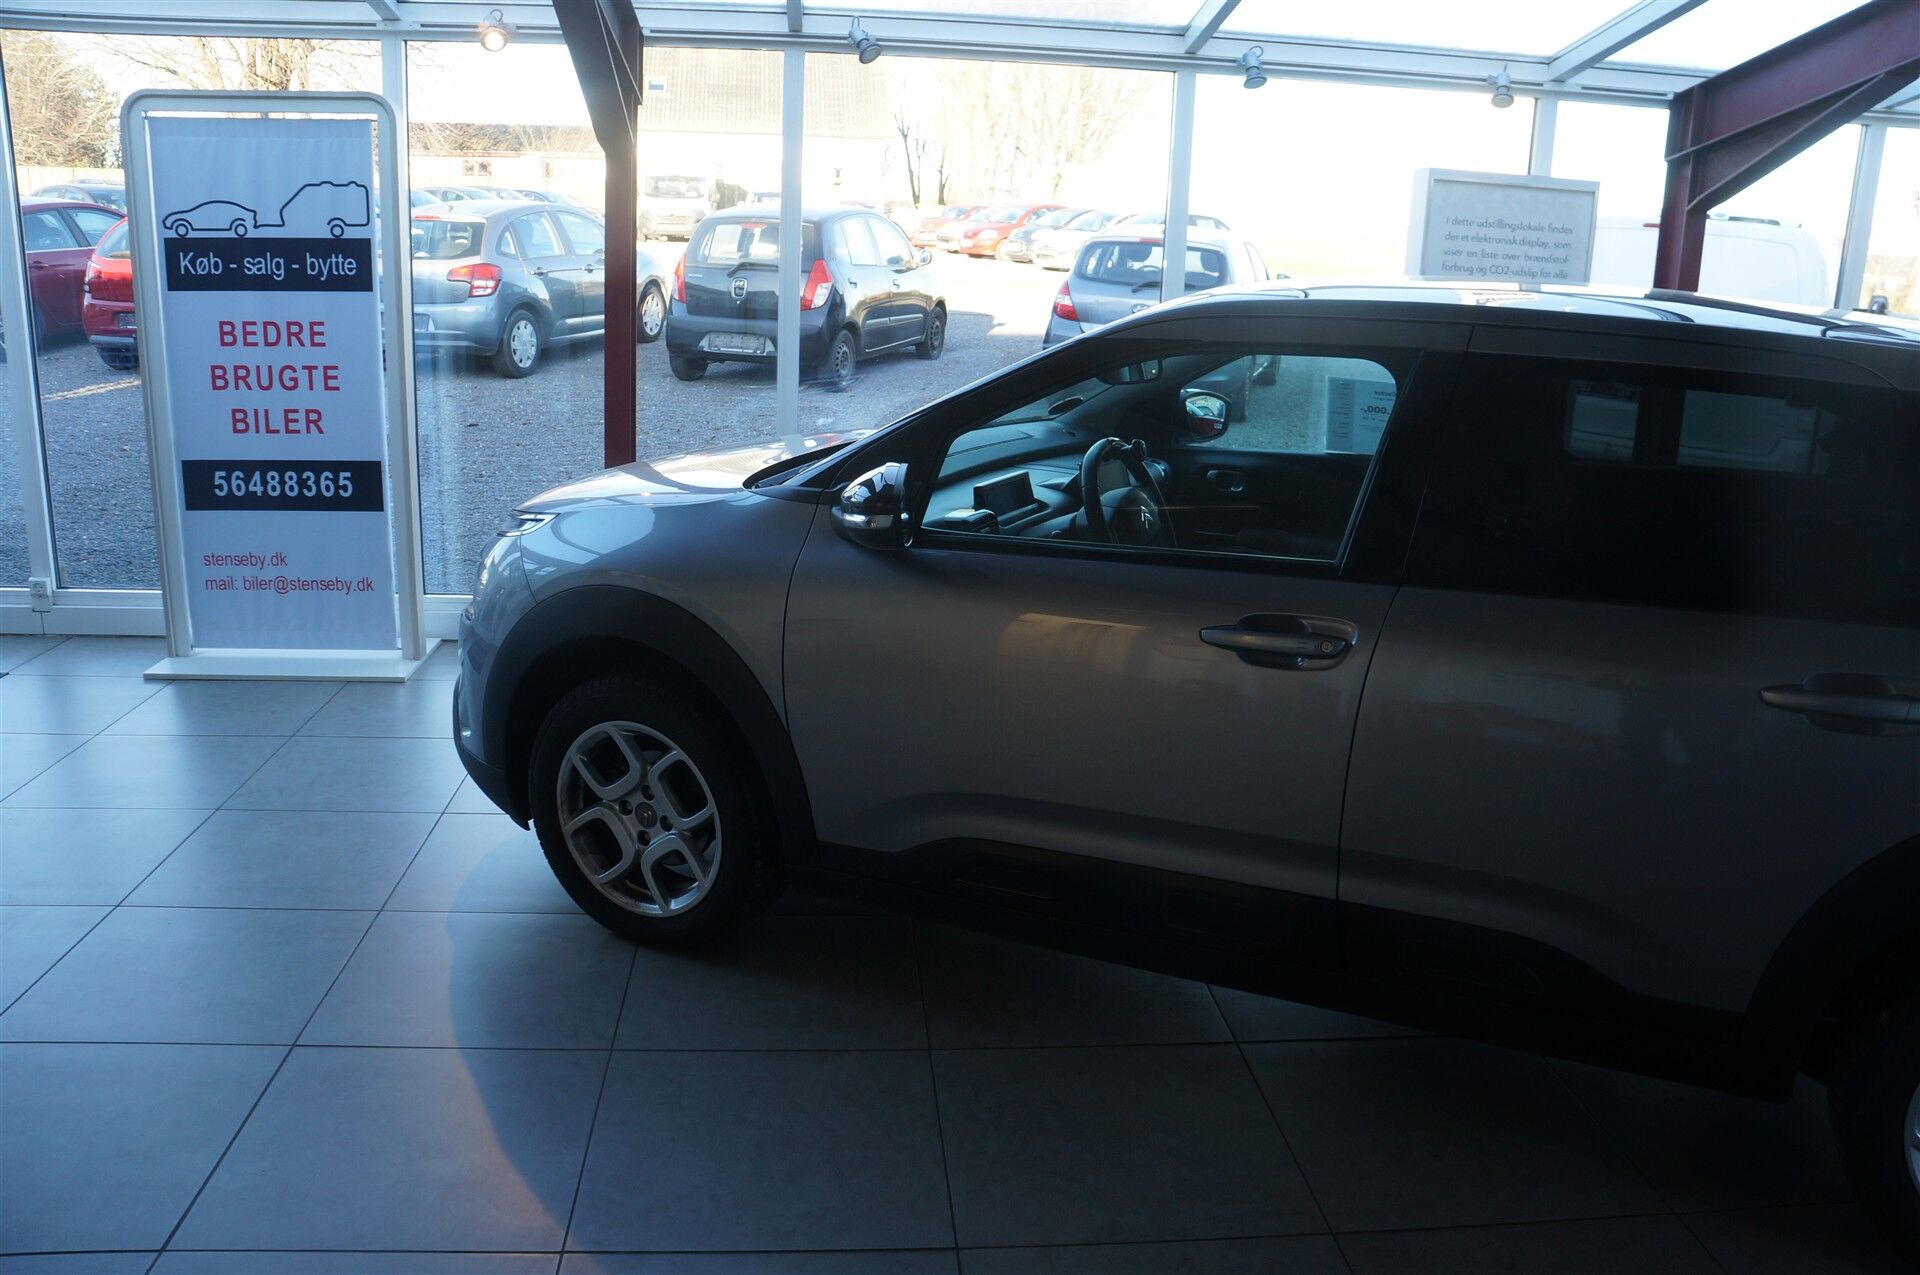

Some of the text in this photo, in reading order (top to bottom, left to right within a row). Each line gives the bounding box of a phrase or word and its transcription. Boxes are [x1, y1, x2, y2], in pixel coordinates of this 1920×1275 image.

[1451, 216, 1474, 227] dette
[1476, 218, 1546, 232] udstillingslokale
[1547, 222, 1573, 234] findes
[1445, 231, 1460, 241] der
[1461, 233, 1470, 242] et
[1470, 233, 1519, 245] elektronisk
[1553, 241, 1572, 249] som
[1443, 249, 1463, 257] viser
[1466, 250, 1478, 258] en
[1481, 249, 1499, 259] liste
[1502, 252, 1520, 261] over
[179, 252, 223, 275] Køb
[243, 252, 285, 281] salg
[306, 252, 357, 281] bytte
[1441, 261, 1568, 280] forbrug og CO2-udslip for alle
[218, 320, 327, 347] BEDRE
[210, 365, 340, 391] BRUGTE
[231, 408, 325, 434] BILER
[213, 471, 353, 497] 56488365
[203, 552, 288, 570] stenseby.dk
[205, 575, 375, 595] mail: biler@stenseby.dk
